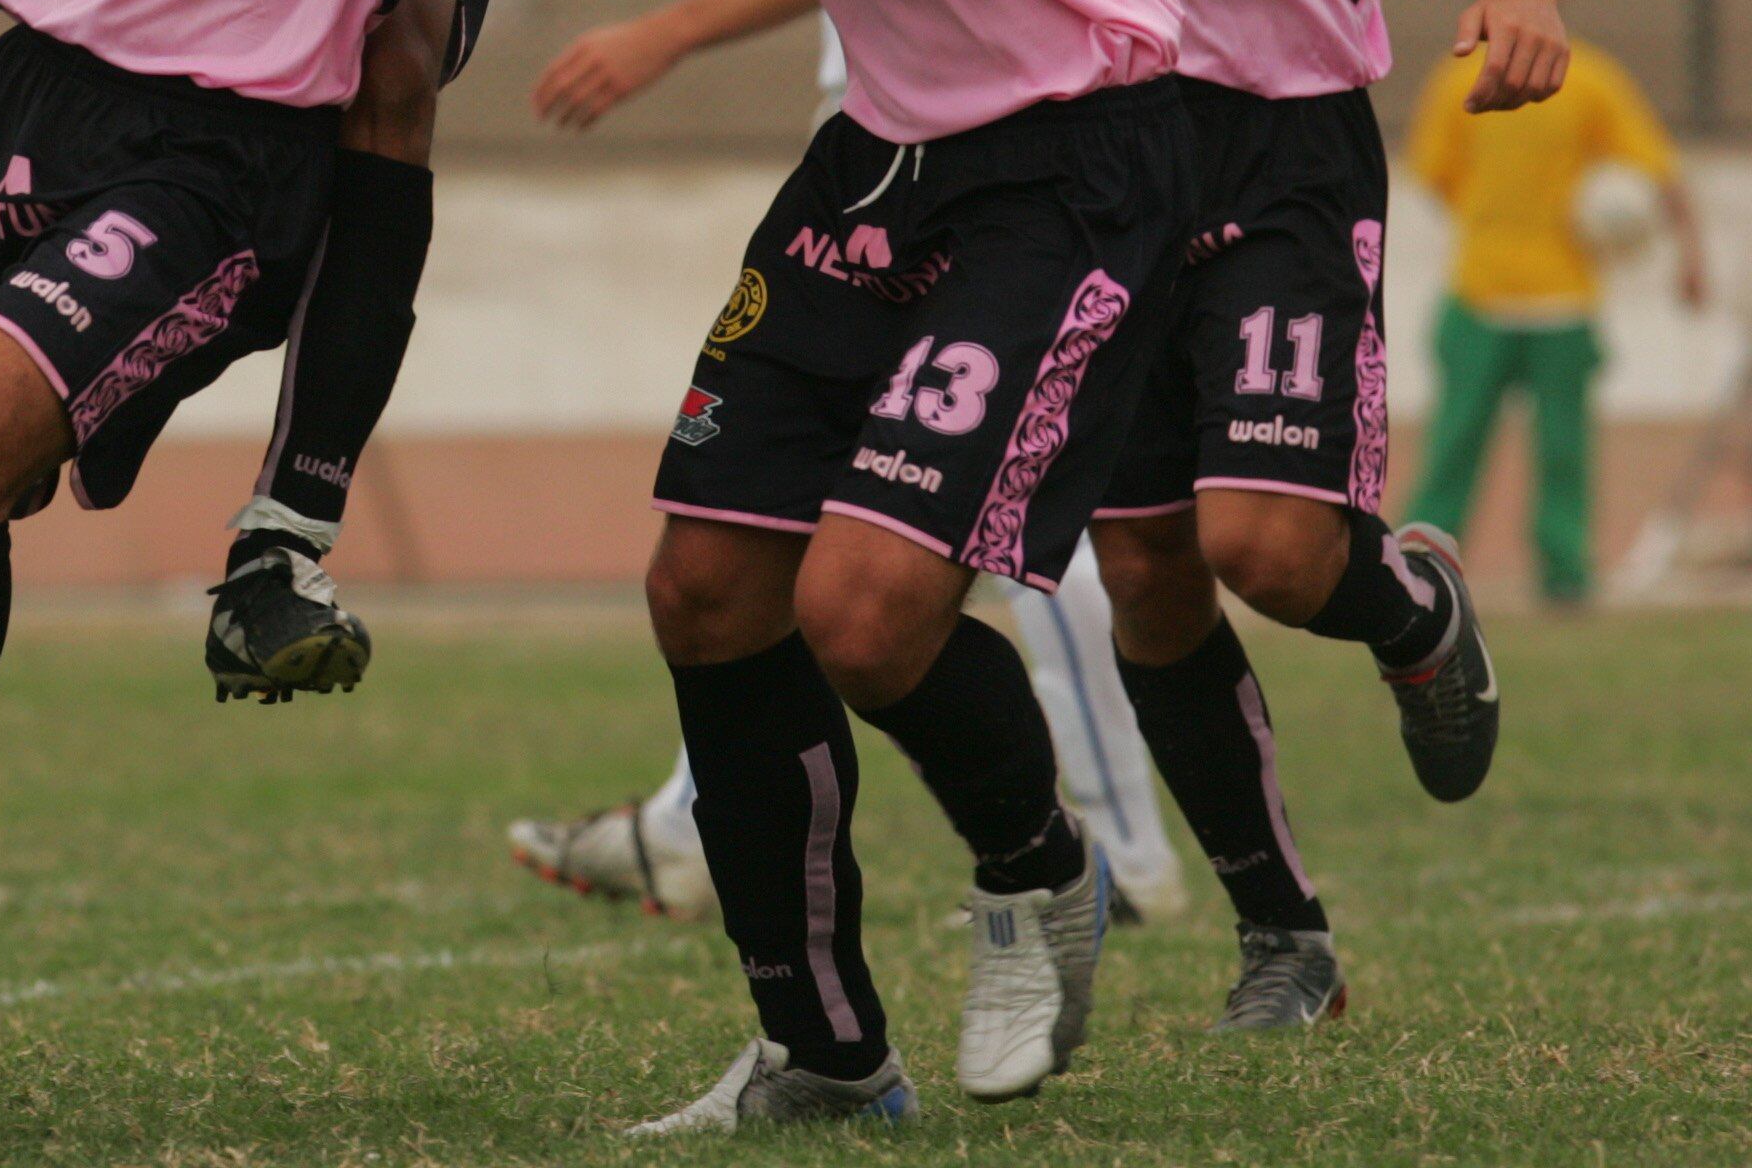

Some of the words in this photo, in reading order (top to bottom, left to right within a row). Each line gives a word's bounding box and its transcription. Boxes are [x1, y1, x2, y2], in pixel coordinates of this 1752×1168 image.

[65, 209, 159, 280] 5
[9, 270, 93, 333] walon
[1234, 305, 1324, 402] 11
[869, 334, 1000, 436] 13
[1228, 414, 1320, 450] walon
[295, 453, 349, 489] walo
[852, 446, 943, 494] walon
[741, 956, 794, 981] alon
